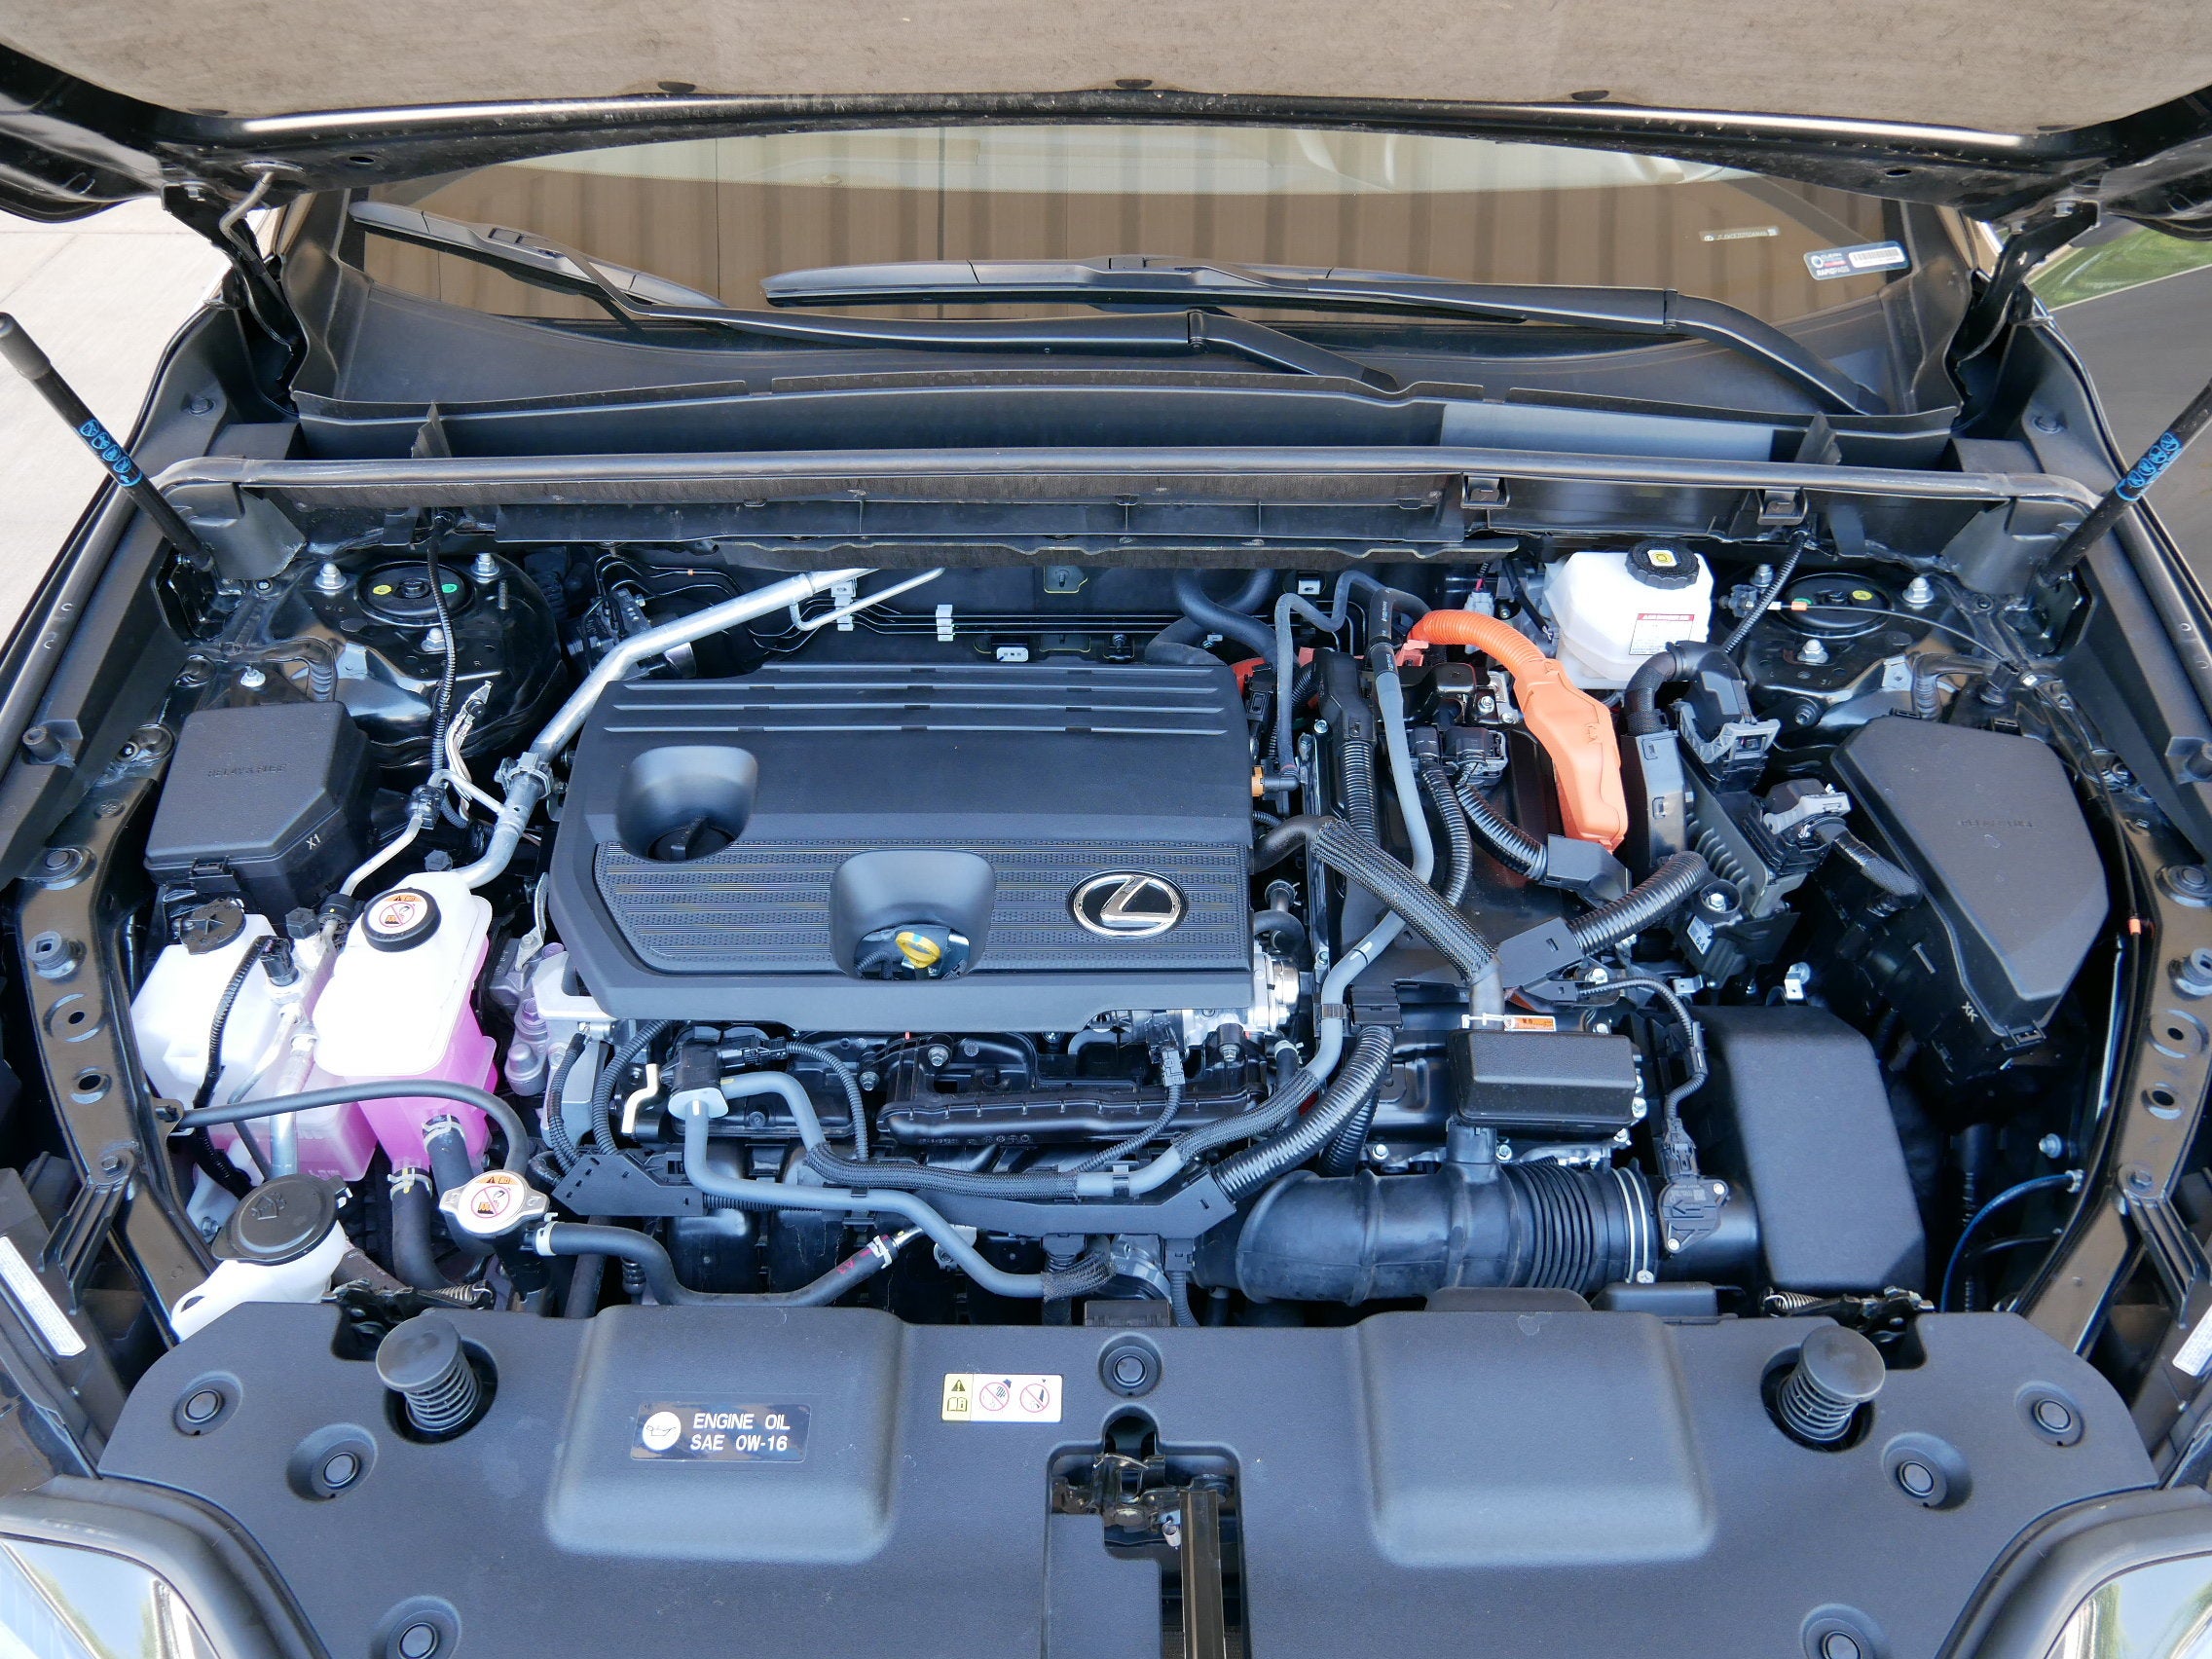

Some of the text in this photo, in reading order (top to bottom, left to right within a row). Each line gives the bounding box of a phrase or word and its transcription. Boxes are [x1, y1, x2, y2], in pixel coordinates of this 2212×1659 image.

[306, 833, 320, 850] X1
[1961, 1001, 1978, 1022] XK
[692, 1414, 791, 1430] ENGINE OIL
[690, 1434, 789, 1452] SAE 0W-16
